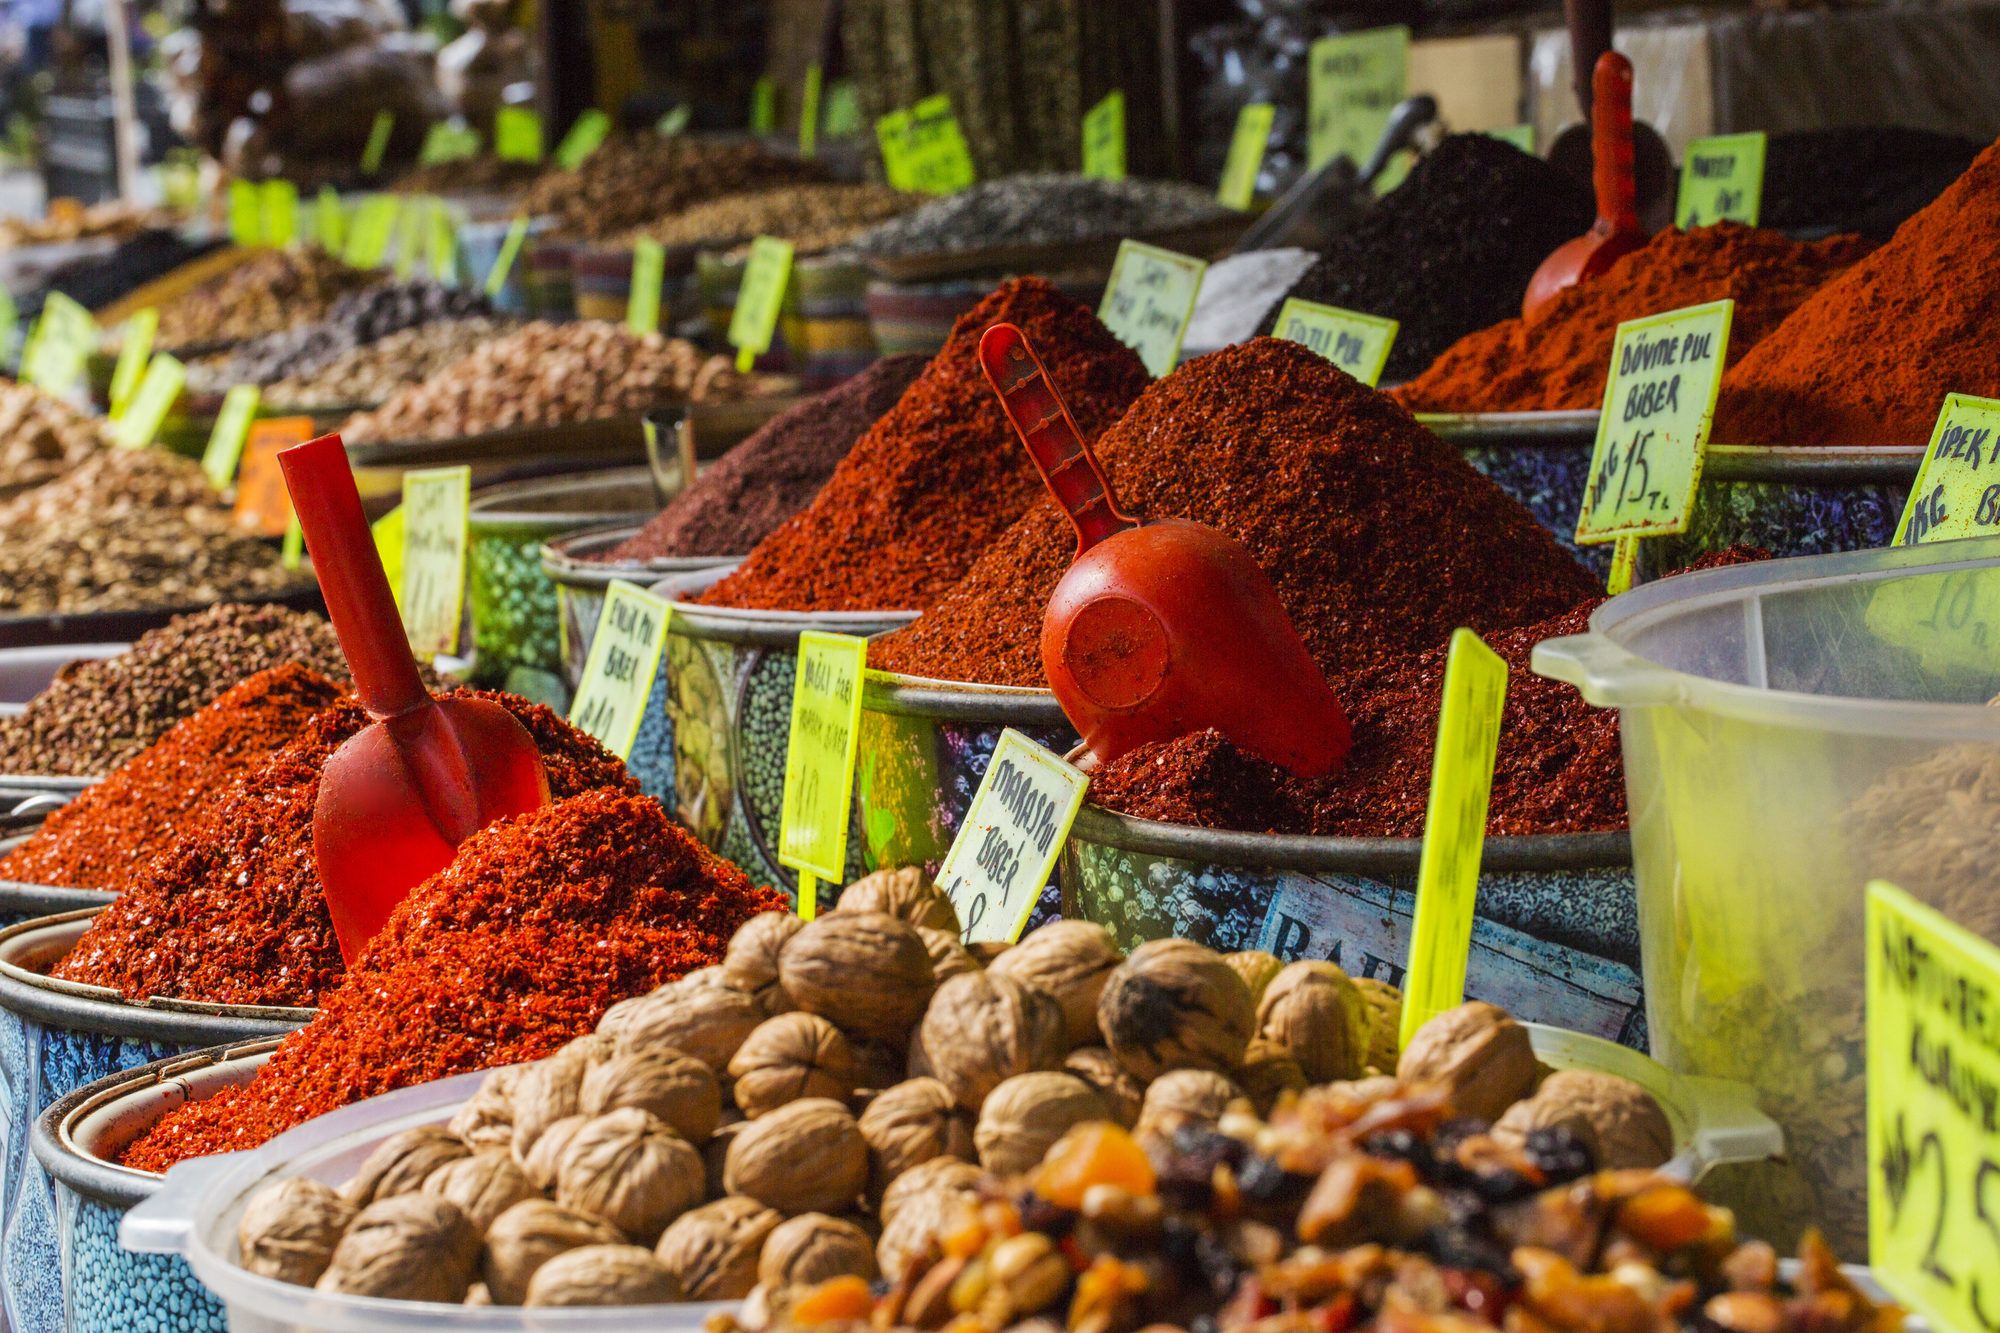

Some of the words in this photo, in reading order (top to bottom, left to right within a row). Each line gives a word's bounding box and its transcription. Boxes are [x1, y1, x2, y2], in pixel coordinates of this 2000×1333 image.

[1620, 332, 1679, 377] DÖVME
[1680, 332, 1712, 364] PUL
[1934, 420, 1990, 471] İPEK
[1614, 430, 1654, 517] 15
